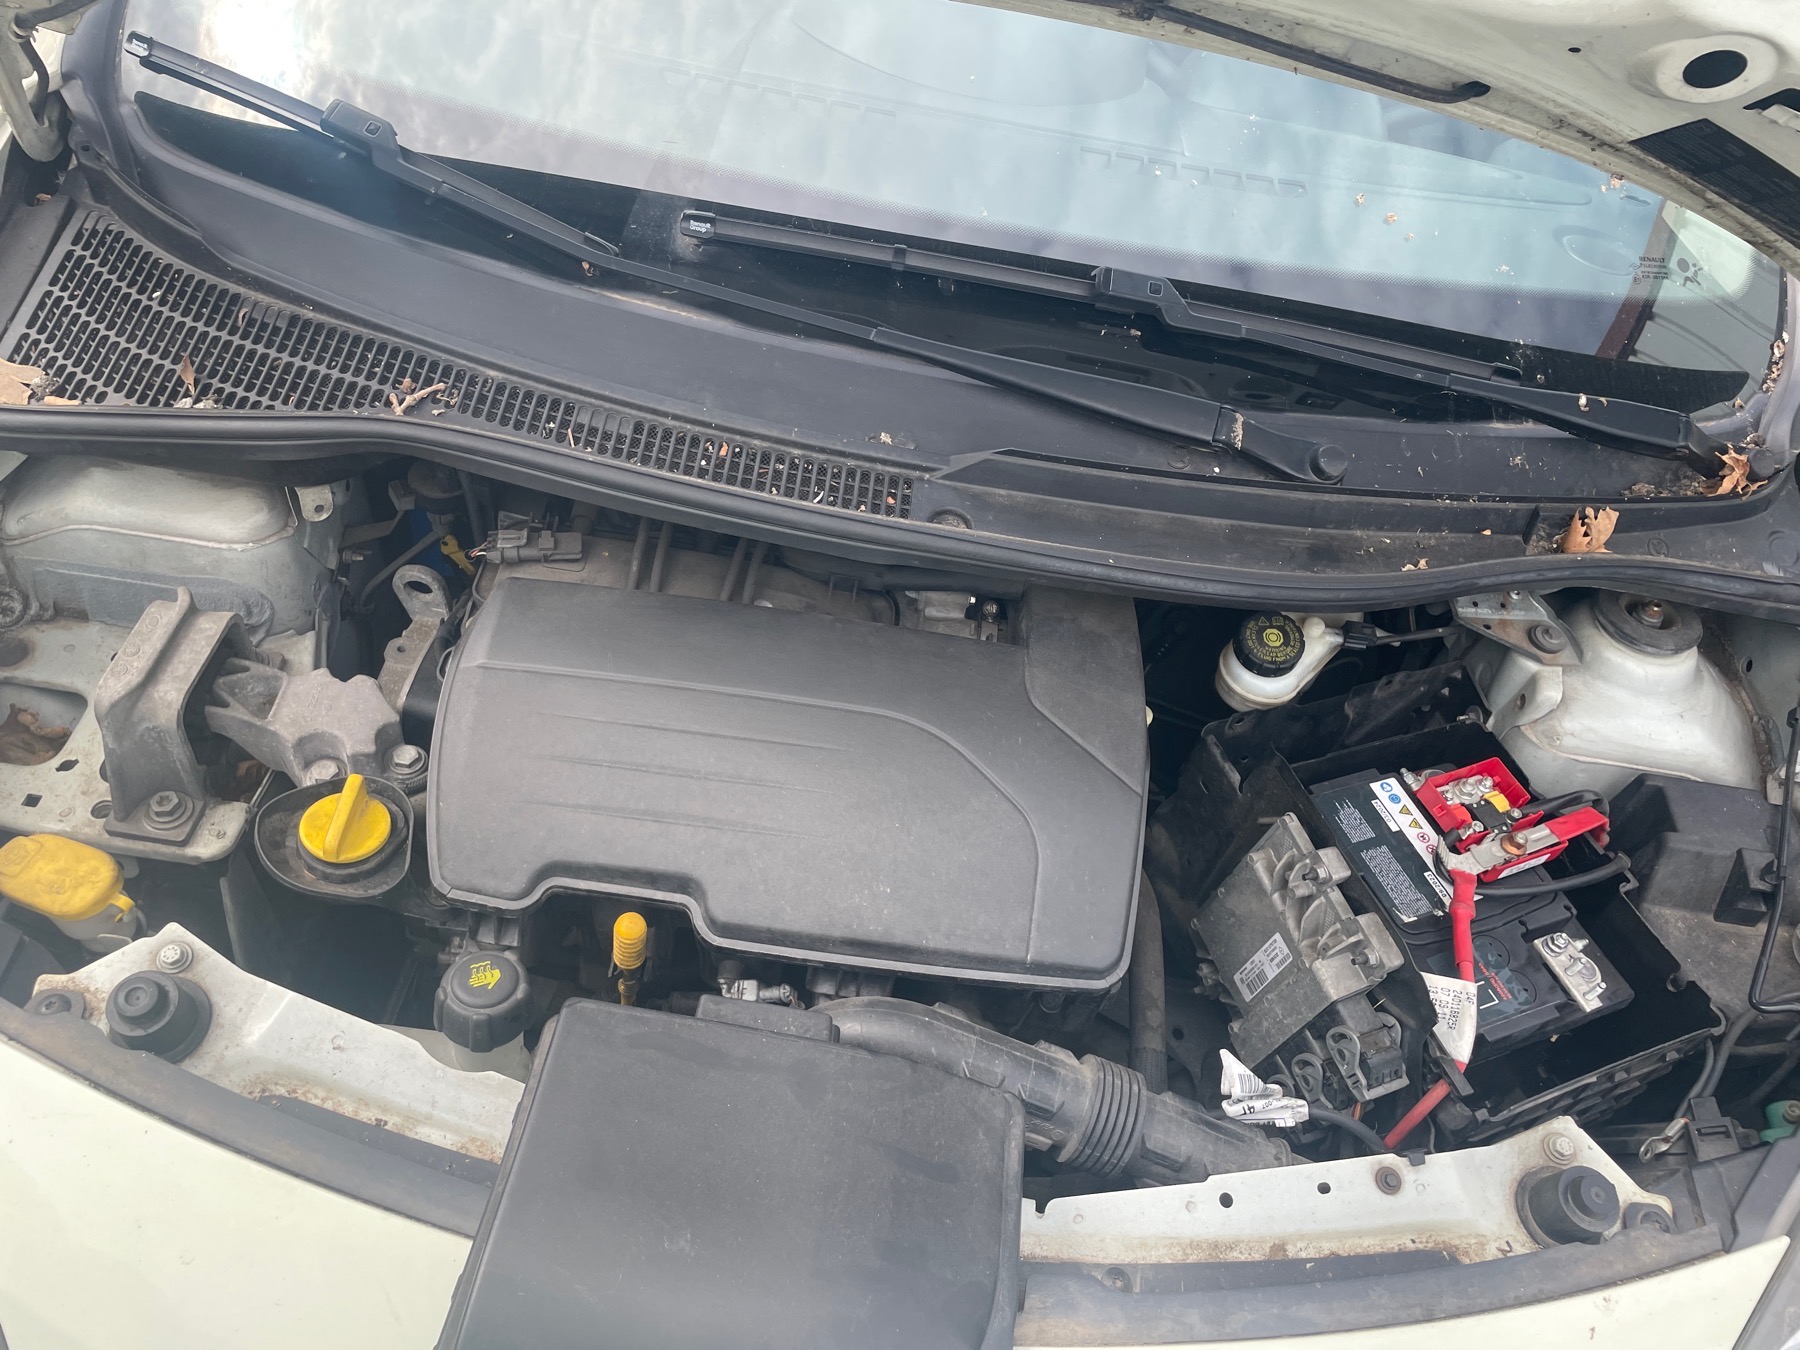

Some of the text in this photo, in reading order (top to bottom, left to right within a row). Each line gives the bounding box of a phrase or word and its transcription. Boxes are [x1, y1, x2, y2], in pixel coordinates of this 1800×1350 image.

[1638, 256, 1665, 264] RENAULT
[1426, 873, 1447, 898] 09/2023
[1440, 987, 1451, 997] 07
